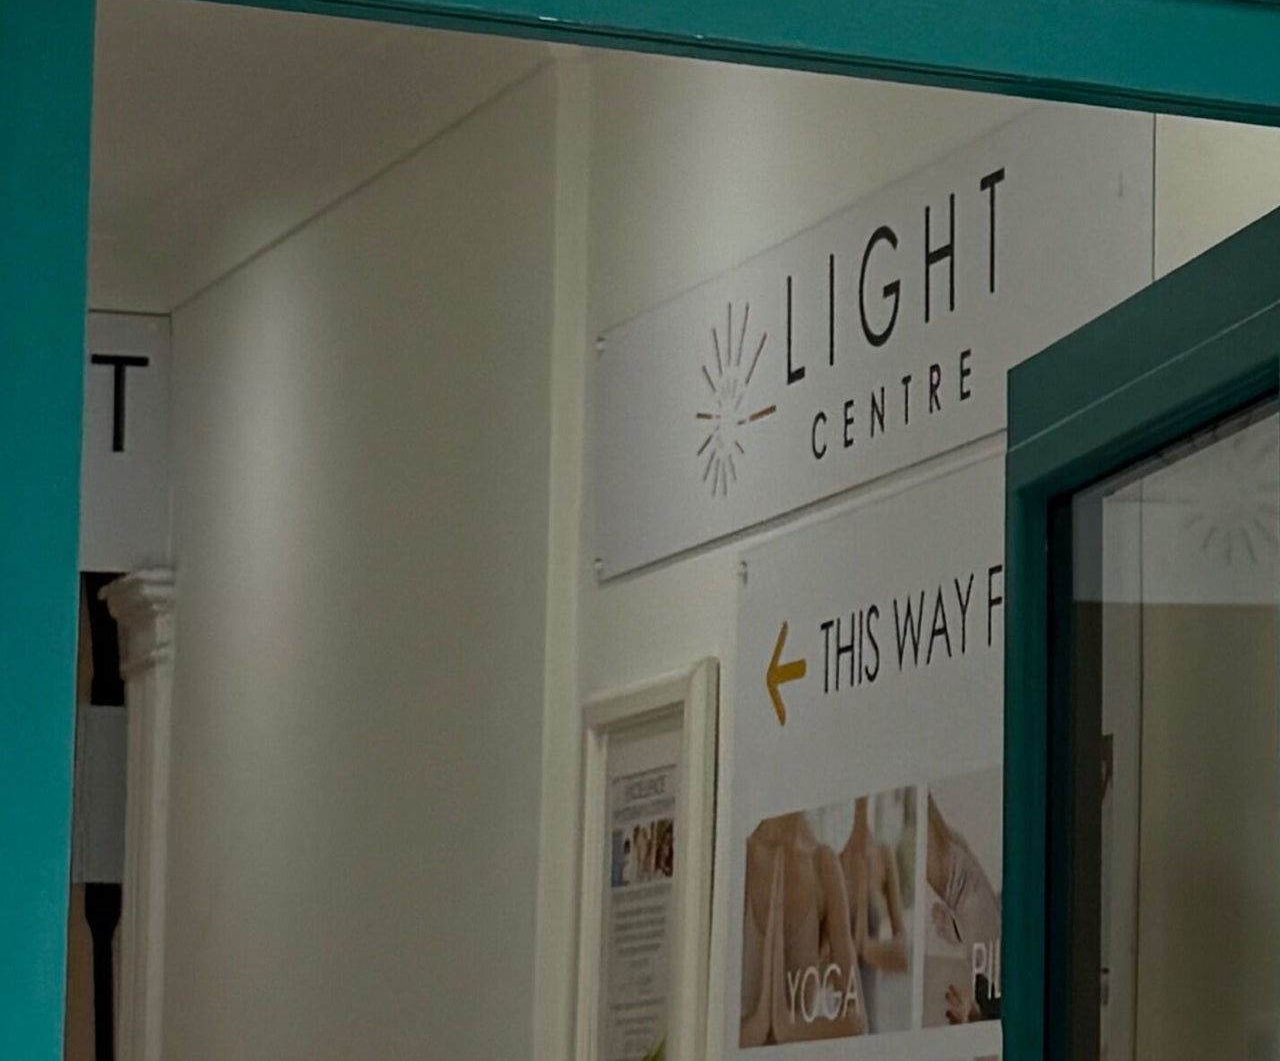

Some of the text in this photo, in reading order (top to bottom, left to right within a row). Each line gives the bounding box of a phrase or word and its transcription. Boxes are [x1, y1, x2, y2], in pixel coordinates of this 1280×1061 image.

[786, 167, 1006, 386] LIGHT
[90, 353, 150, 453] T
[811, 348, 972, 460] CENTRE
[820, 602, 880, 695] THIS
[893, 572, 975, 672] WAY
[787, 962, 861, 1025] YOGA
